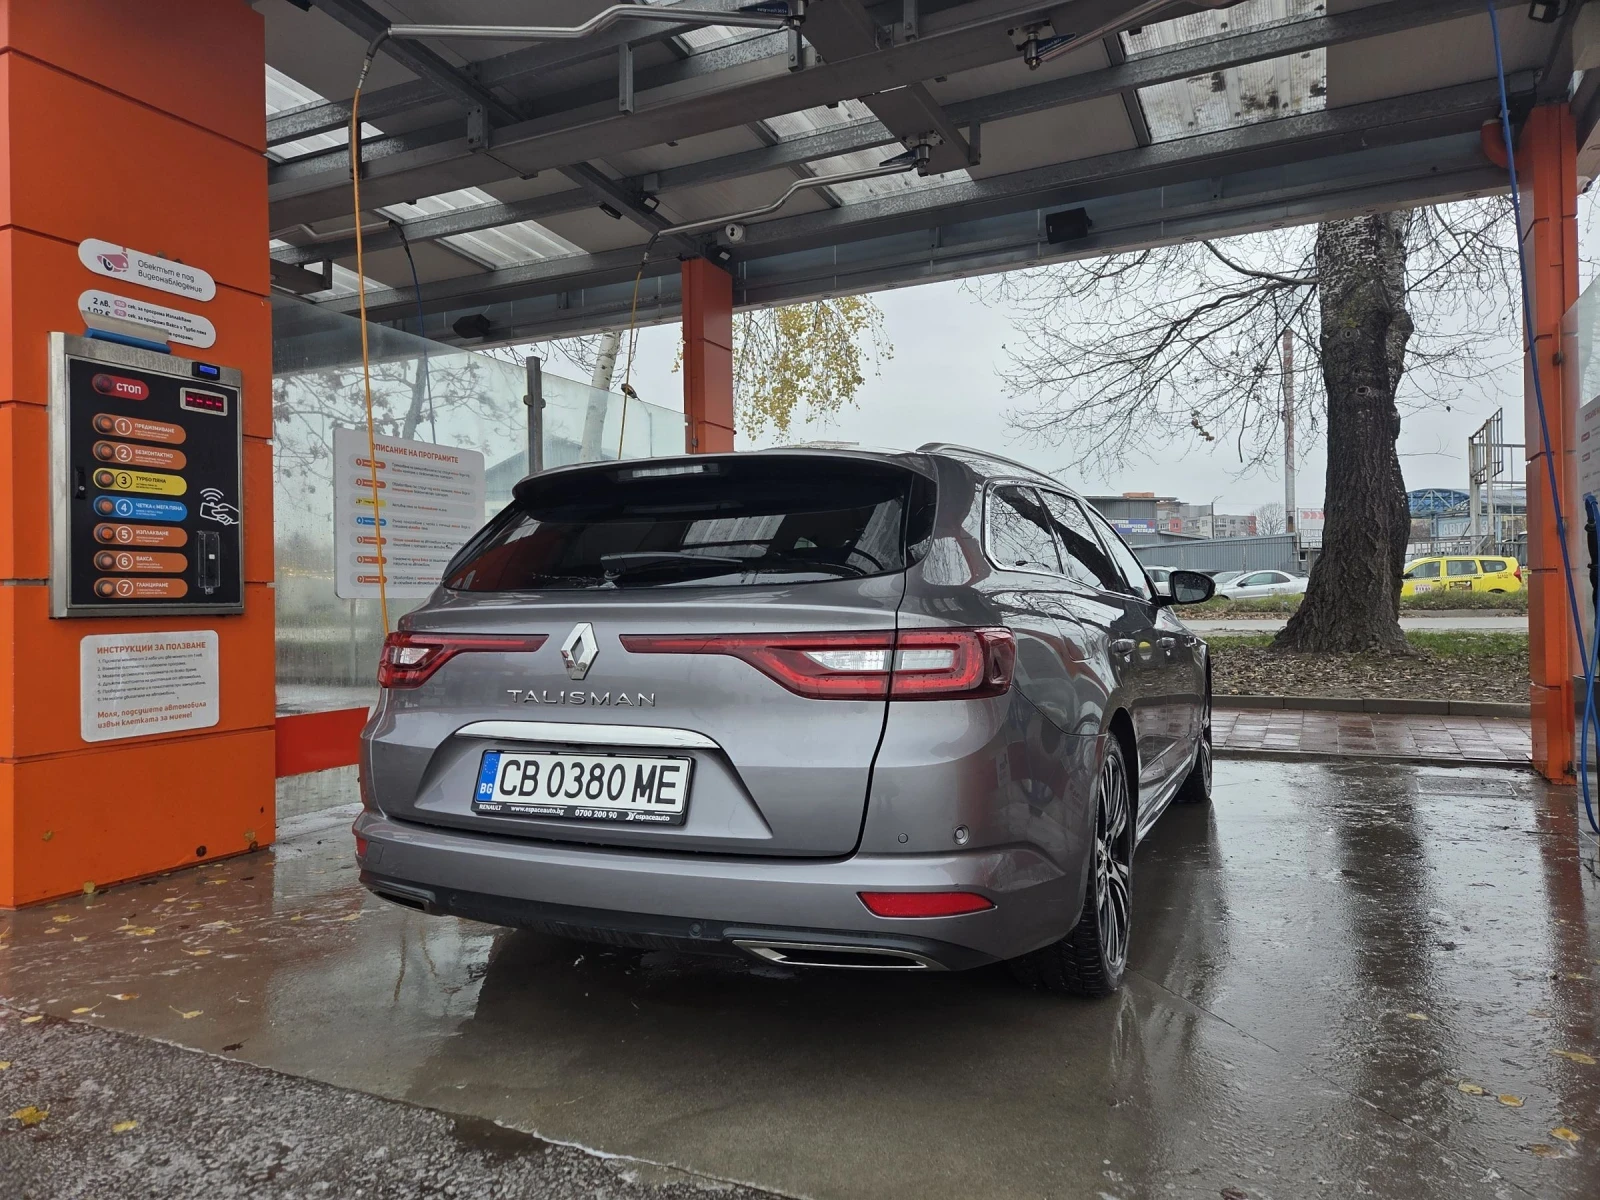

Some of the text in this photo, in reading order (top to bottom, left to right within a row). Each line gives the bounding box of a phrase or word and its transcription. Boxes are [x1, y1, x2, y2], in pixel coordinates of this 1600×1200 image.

[138, 260, 174, 276] Обектът
[181, 273, 194, 283] под
[100, 300, 111, 308] лв.
[116, 383, 142, 395] СТОП
[121, 422, 175, 434] 1 ПРЕДИЗМИВАНЕ
[121, 449, 174, 459] 2 БЕЗКОНТАКТНО
[408, 449, 418, 458] НА
[418, 451, 459, 464] ПРОГРАМИТЕ
[121, 476, 127, 485] 3
[121, 503, 127, 512] 4
[121, 529, 169, 539] 5 ИЗПЛАКВАНЕ
[121, 557, 128, 566] 6
[122, 584, 128, 593] 7
[97, 642, 206, 654] ИНСТРУКЦИИ ЗА ПОЛЗВАНЕ
[507, 689, 656, 707] TALISMAN
[97, 702, 207, 719] Моля, подсушете автомобила
[97, 721, 120, 729] извън
[121, 716, 158, 726] клетката
[169, 711, 192, 721] миене!
[480, 782, 493, 794] BG
[499, 759, 681, 805] CB 0380 ME
[511, 805, 564, 816] www.espaceauto.bg
[575, 809, 591, 817] 0700
[593, 810, 606, 818] 200
[608, 811, 618, 819] 90
[635, 813, 670, 822] espaceauto
